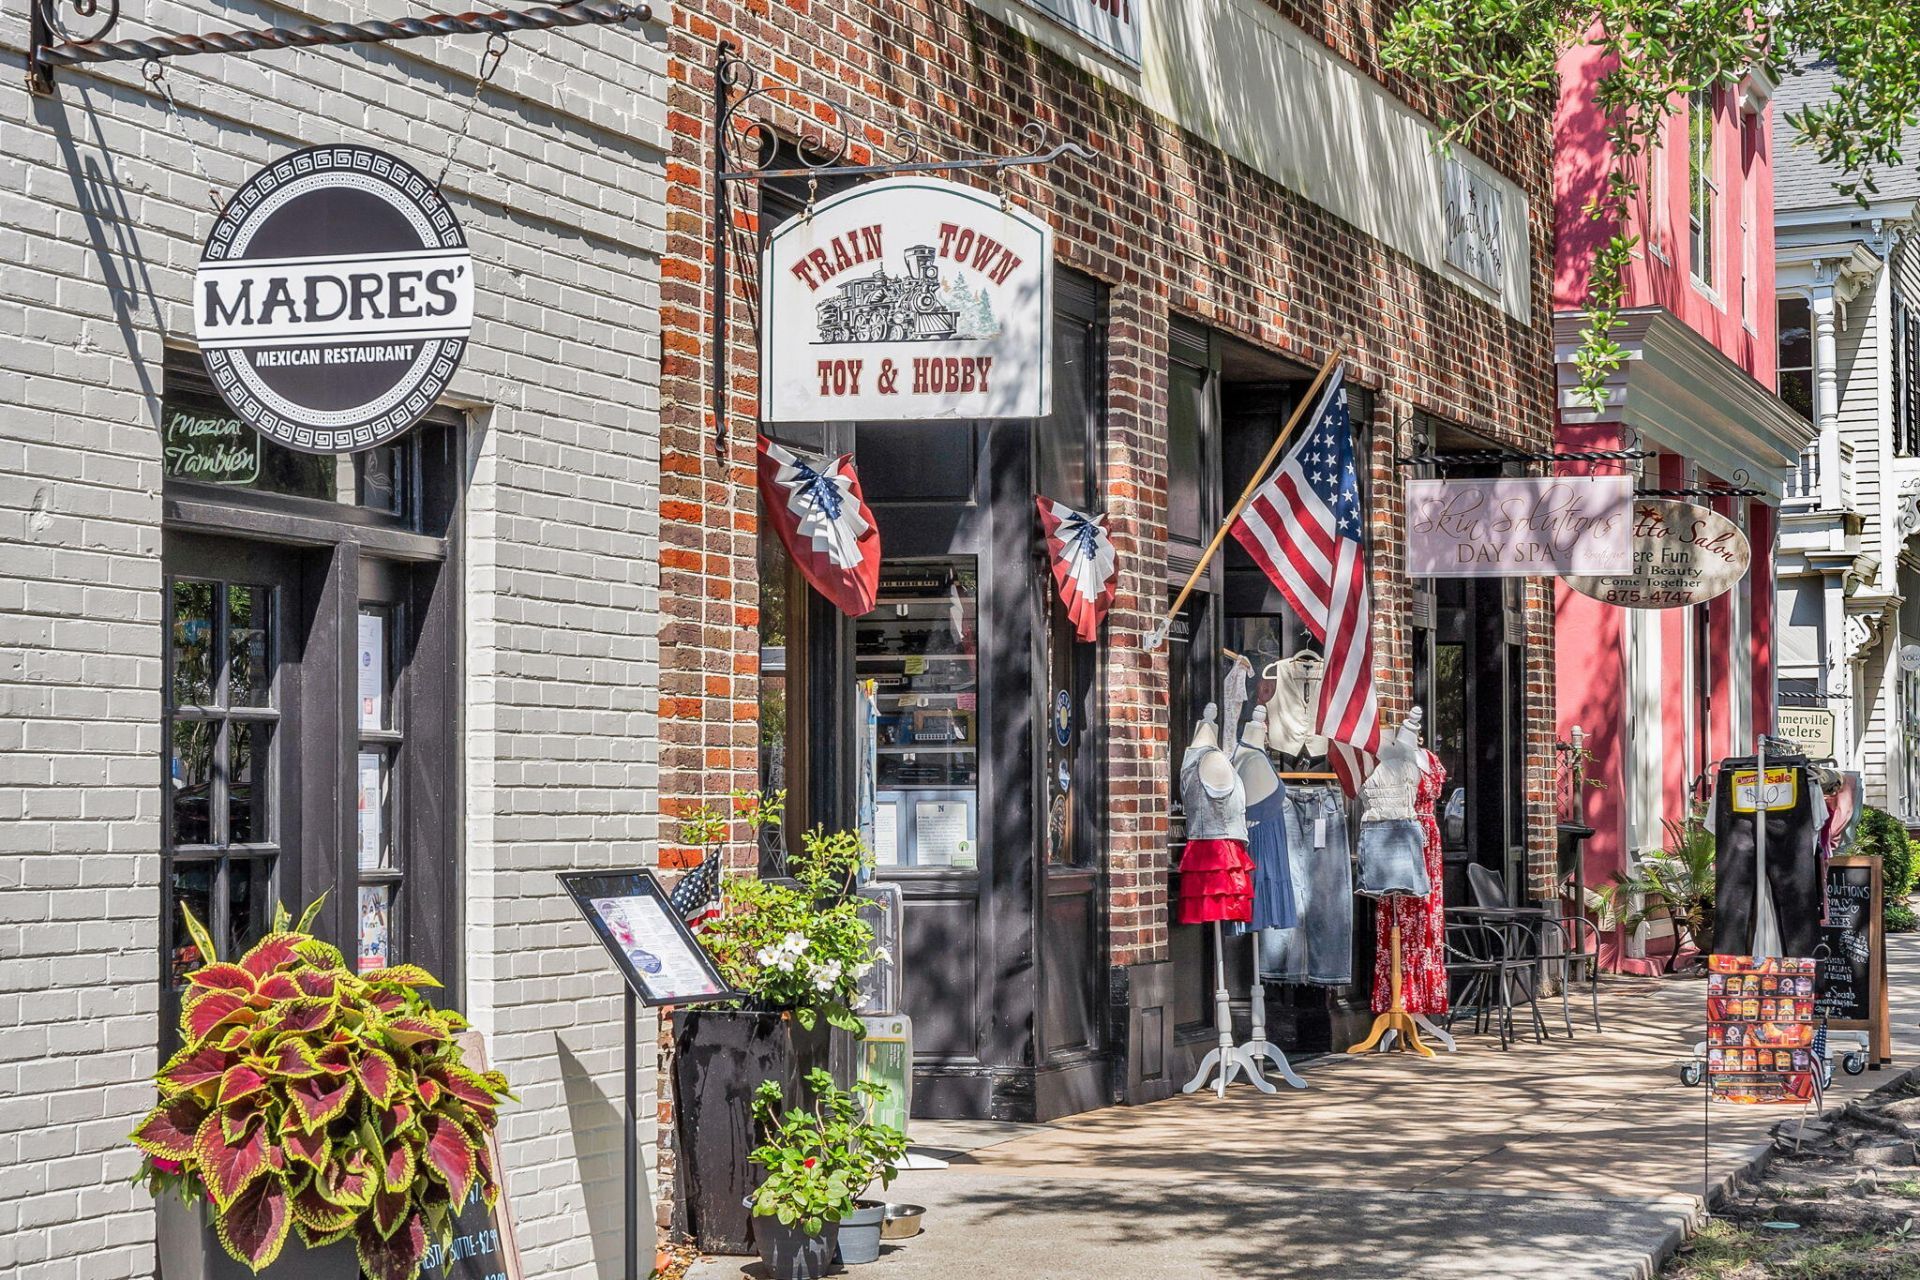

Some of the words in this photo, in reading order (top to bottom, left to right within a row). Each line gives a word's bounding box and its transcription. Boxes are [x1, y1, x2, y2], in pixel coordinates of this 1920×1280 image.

[789, 223, 884, 292] TRAIN
[937, 222, 1024, 286] TOWN
[203, 264, 465, 327] MADRES'
[256, 349, 320, 367] MEXICAN
[324, 345, 415, 364] RESTAURANT
[817, 359, 863, 396] TOY
[877, 358, 899, 395] &
[912, 356, 992, 394] HOBBY
[1414, 487, 1484, 541] Skin
[1492, 483, 1622, 553] Solutions
[1679, 520, 1736, 563] Salon
[1458, 543, 1506, 563] DAY
[1514, 542, 1557, 563] SPA
[1633, 551, 1654, 563] ere
[1661, 547, 1689, 564] Fun
[1651, 566, 1703, 578] Beauty
[1600, 577, 1640, 587] Come
[1646, 577, 1702, 589] Together
[1606, 590, 1693, 603] 875-4747
[1778, 725, 1821, 738] welers
[1768, 773, 1792, 784] sale
